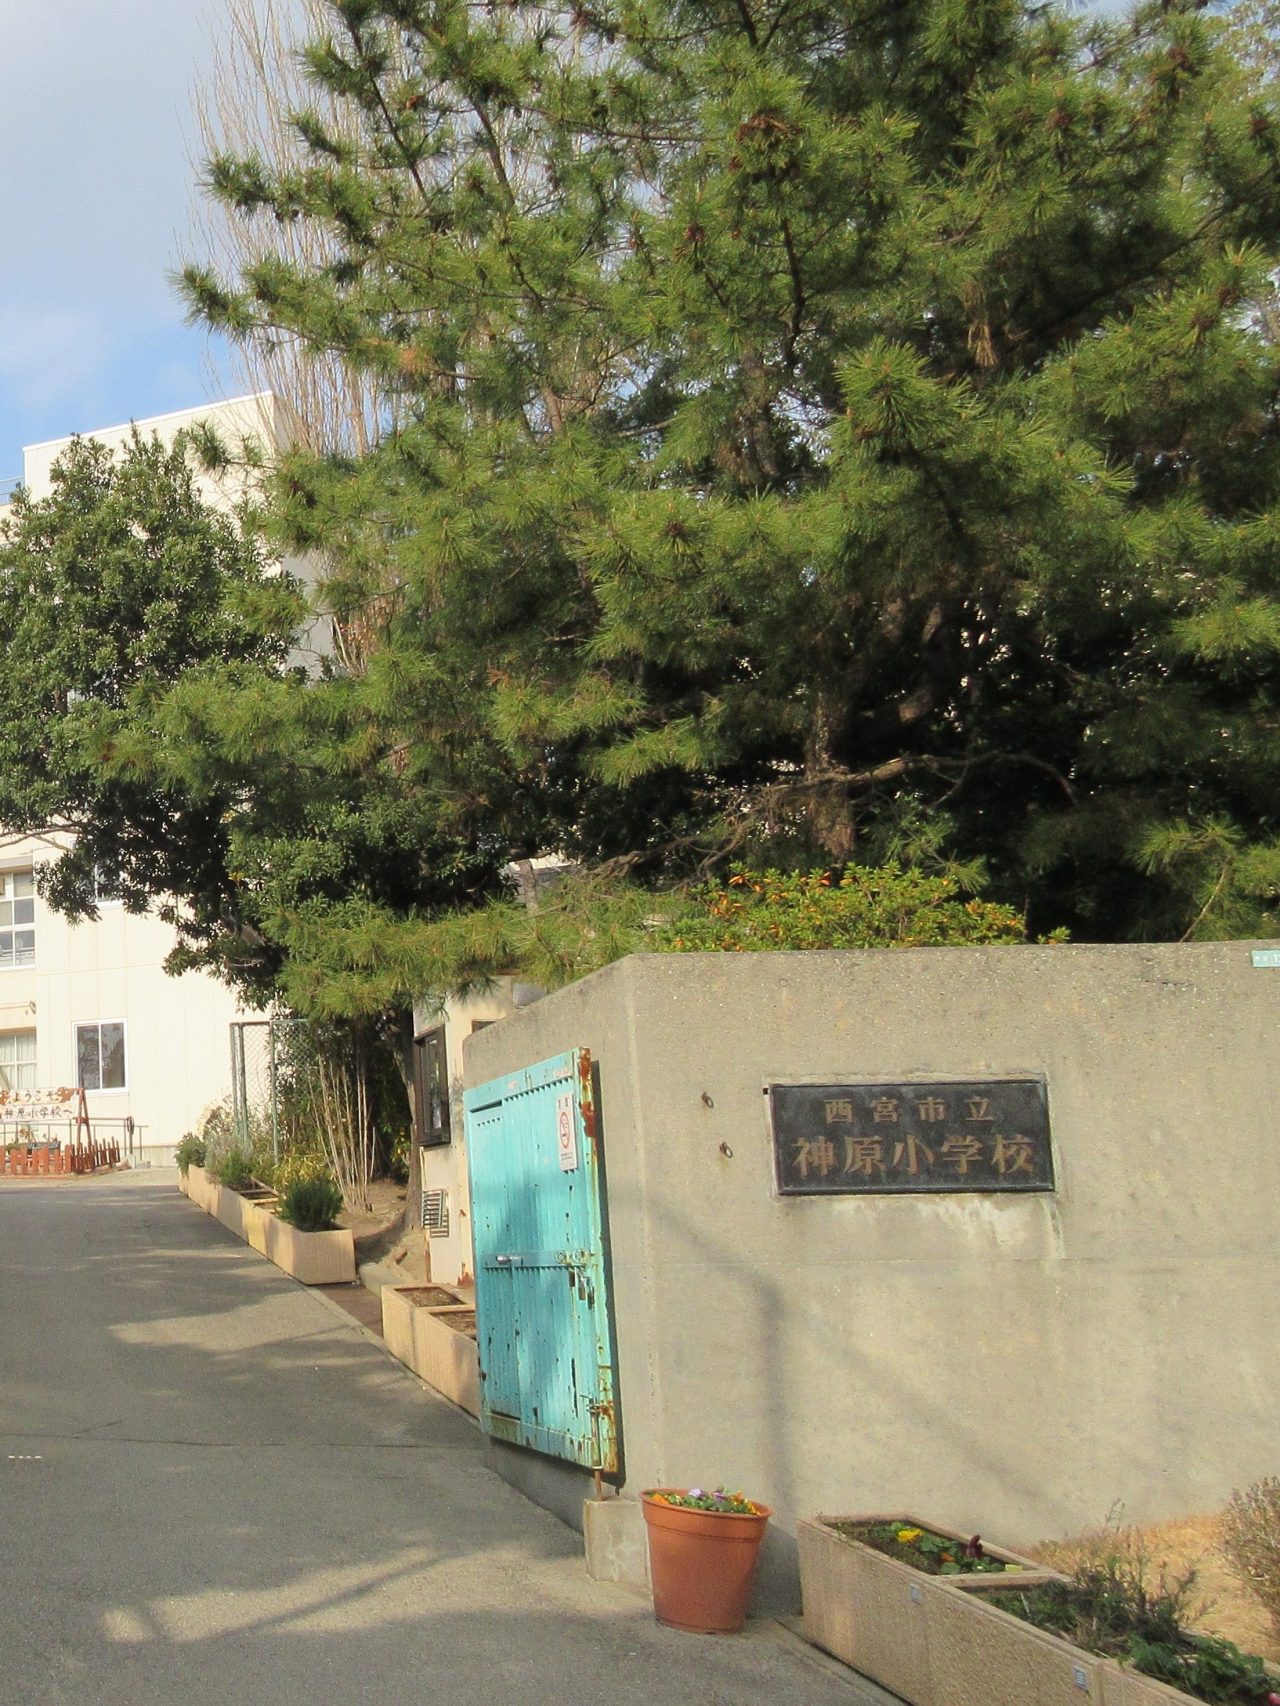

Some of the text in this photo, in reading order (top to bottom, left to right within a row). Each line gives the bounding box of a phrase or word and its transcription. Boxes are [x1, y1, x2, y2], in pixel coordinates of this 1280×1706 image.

[12, 1089, 54, 1103] ようこそ
[824, 1096, 994, 1124] 西宮市立
[792, 1132, 1035, 1179] 神原小学校
